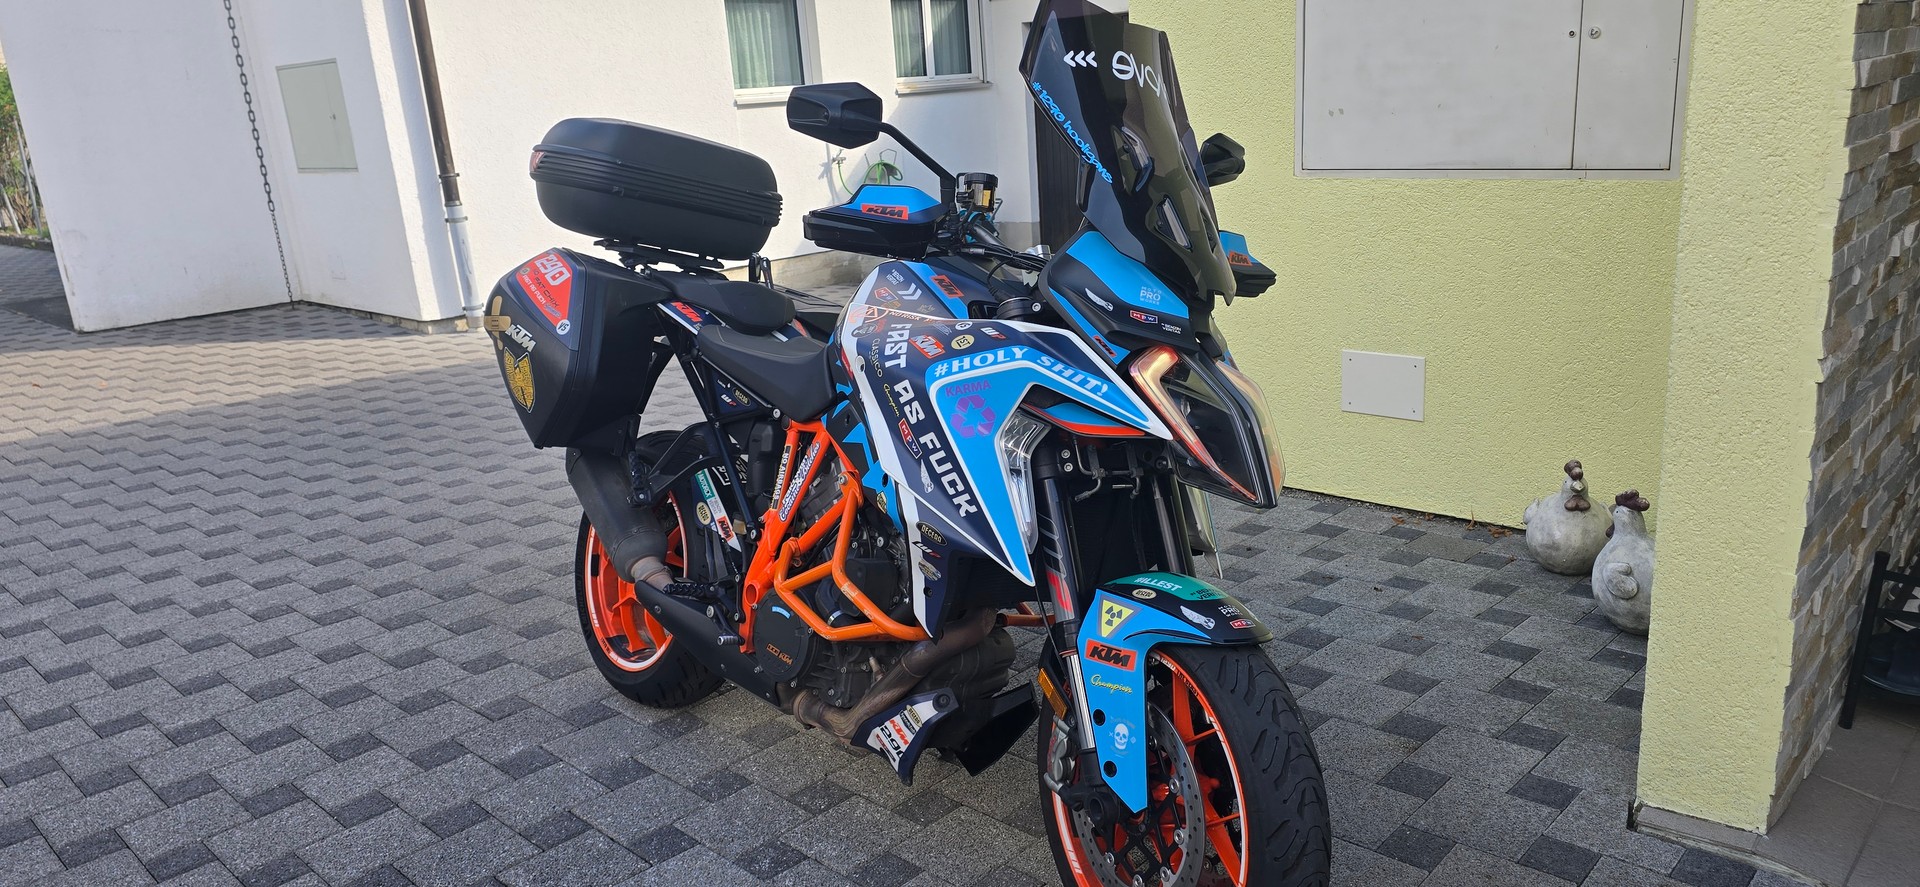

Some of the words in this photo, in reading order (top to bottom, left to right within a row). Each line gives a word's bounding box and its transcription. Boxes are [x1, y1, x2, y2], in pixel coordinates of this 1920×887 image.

[1032, 82, 1065, 122] #1290
[1063, 120, 1113, 184] hooligans
[866, 205, 903, 218] KTM
[1231, 252, 1249, 264] KTM
[934, 278, 960, 295] KTM
[1140, 290, 1161, 300] PRO
[671, 301, 703, 322] KTM
[505, 324, 536, 352] KTM
[884, 323, 913, 369] FAST
[911, 335, 943, 357] KTM
[934, 347, 1029, 378] #HOLY
[1037, 355, 1109, 397] SHIT!
[945, 379, 992, 398] KARMA
[893, 379, 926, 425] AS
[901, 424, 919, 452] MPW
[782, 453, 789, 464] NO
[697, 473, 714, 498] MOTOREX
[773, 465, 786, 500] AIRBAGS
[919, 431, 978, 518] FUCK
[718, 519, 732, 539] KTM
[779, 652, 793, 665] KTM
[1089, 644, 1131, 667] KTM
[1090, 674, 1133, 695] Champion
[889, 719, 909, 746] KTM
